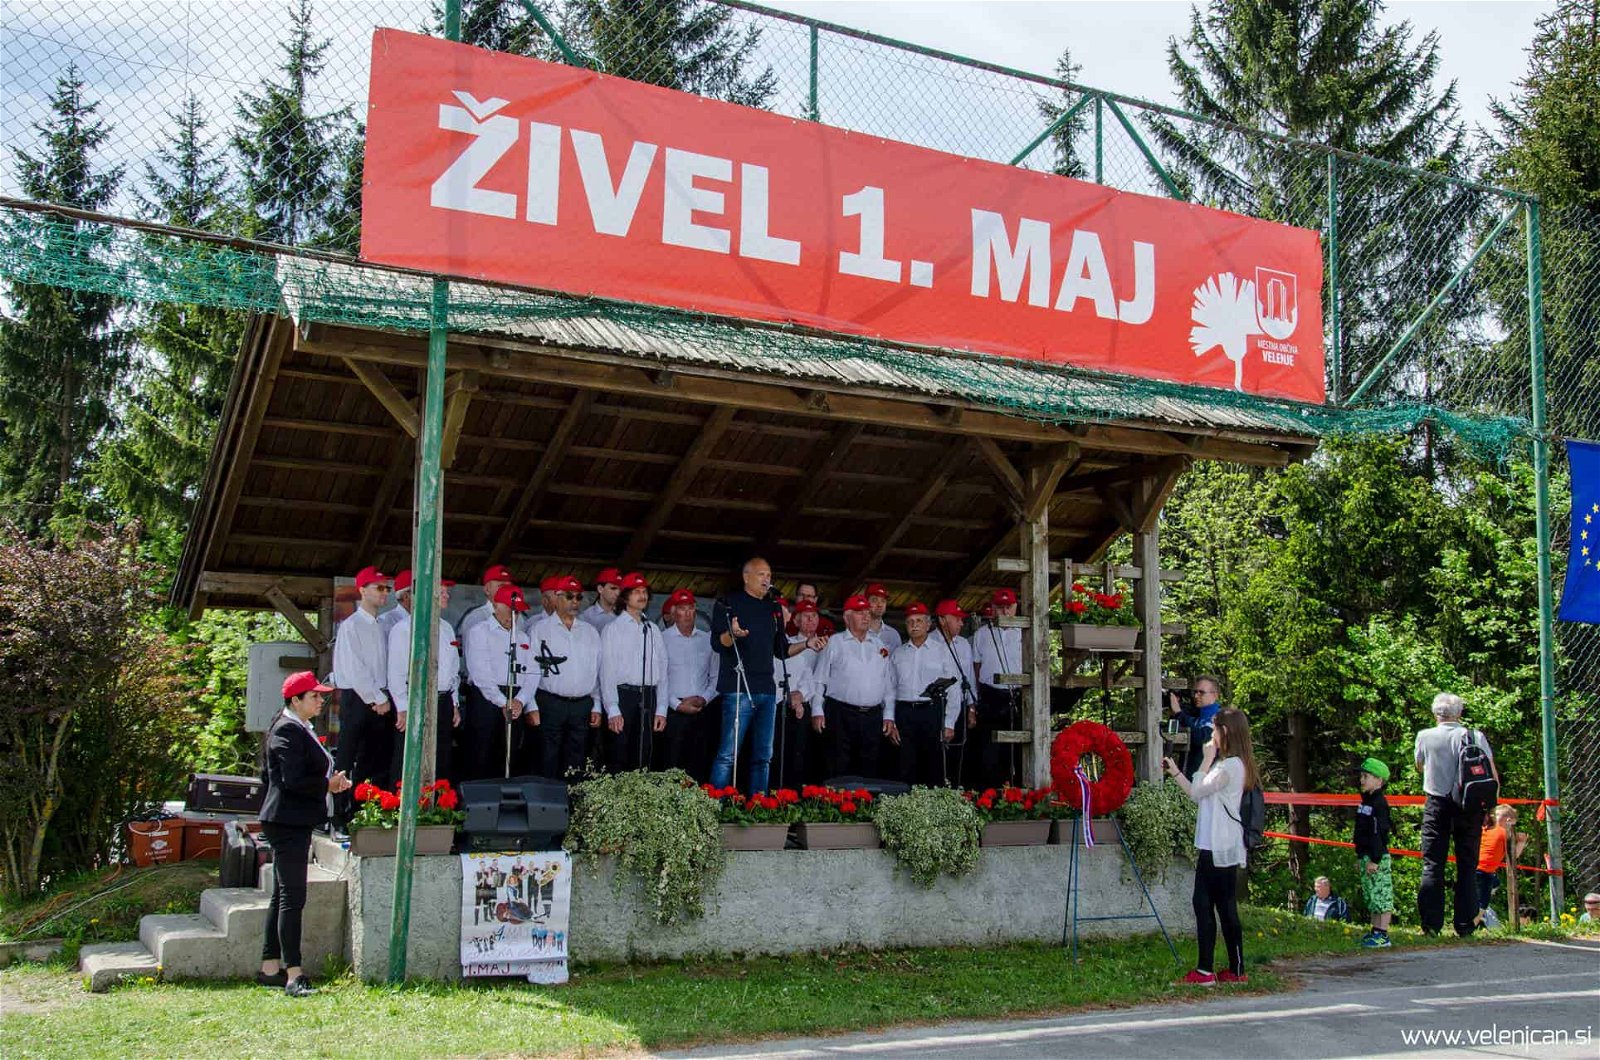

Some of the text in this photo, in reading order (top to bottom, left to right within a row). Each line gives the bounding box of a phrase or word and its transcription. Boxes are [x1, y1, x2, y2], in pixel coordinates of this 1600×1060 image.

[430, 90, 1155, 325] ŽIVEL 1. MAJ
[1262, 350, 1295, 366] VELENJE
